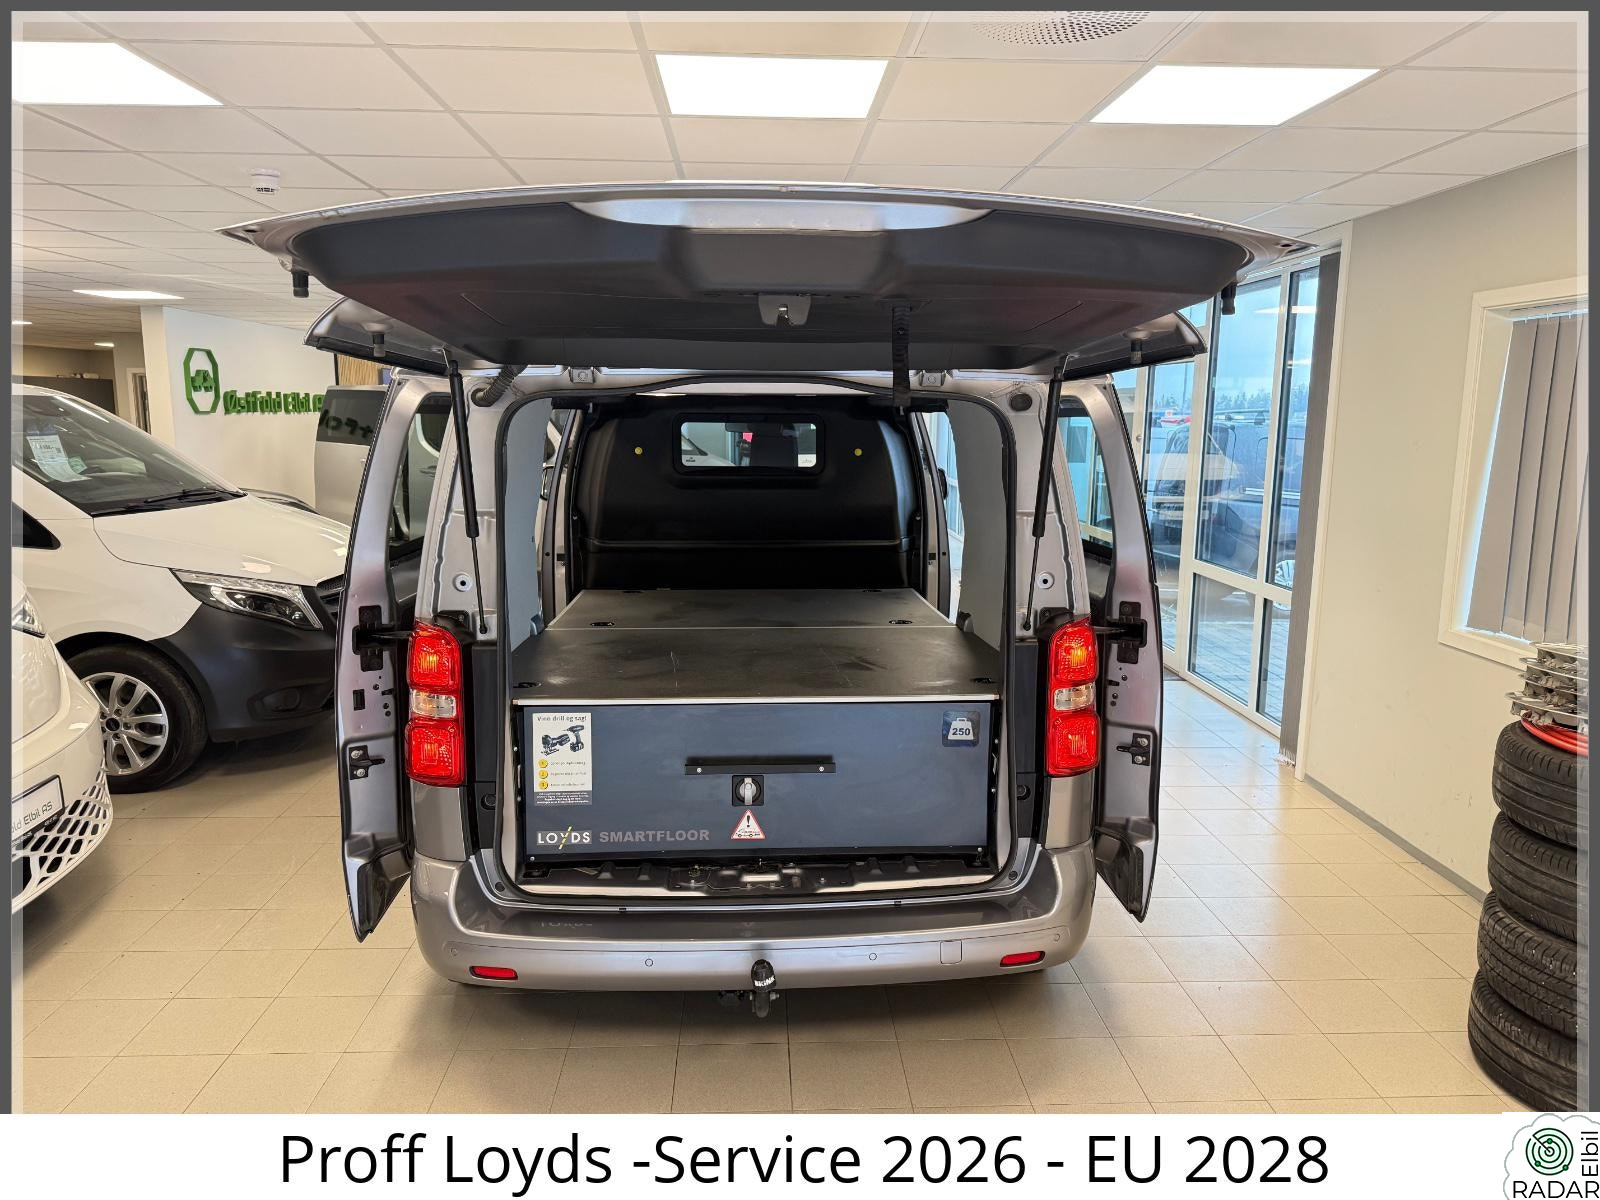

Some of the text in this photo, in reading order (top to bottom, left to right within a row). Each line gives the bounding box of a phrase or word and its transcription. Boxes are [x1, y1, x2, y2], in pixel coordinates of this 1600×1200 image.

[223, 390, 282, 414] Østfold
[283, 392, 312, 414] Elbil
[952, 728, 971, 736] 250
[24, 808, 41, 825] Elbil
[41, 801, 53, 815] AS
[537, 828, 710, 847] LOYDS SMARTFLOOR
